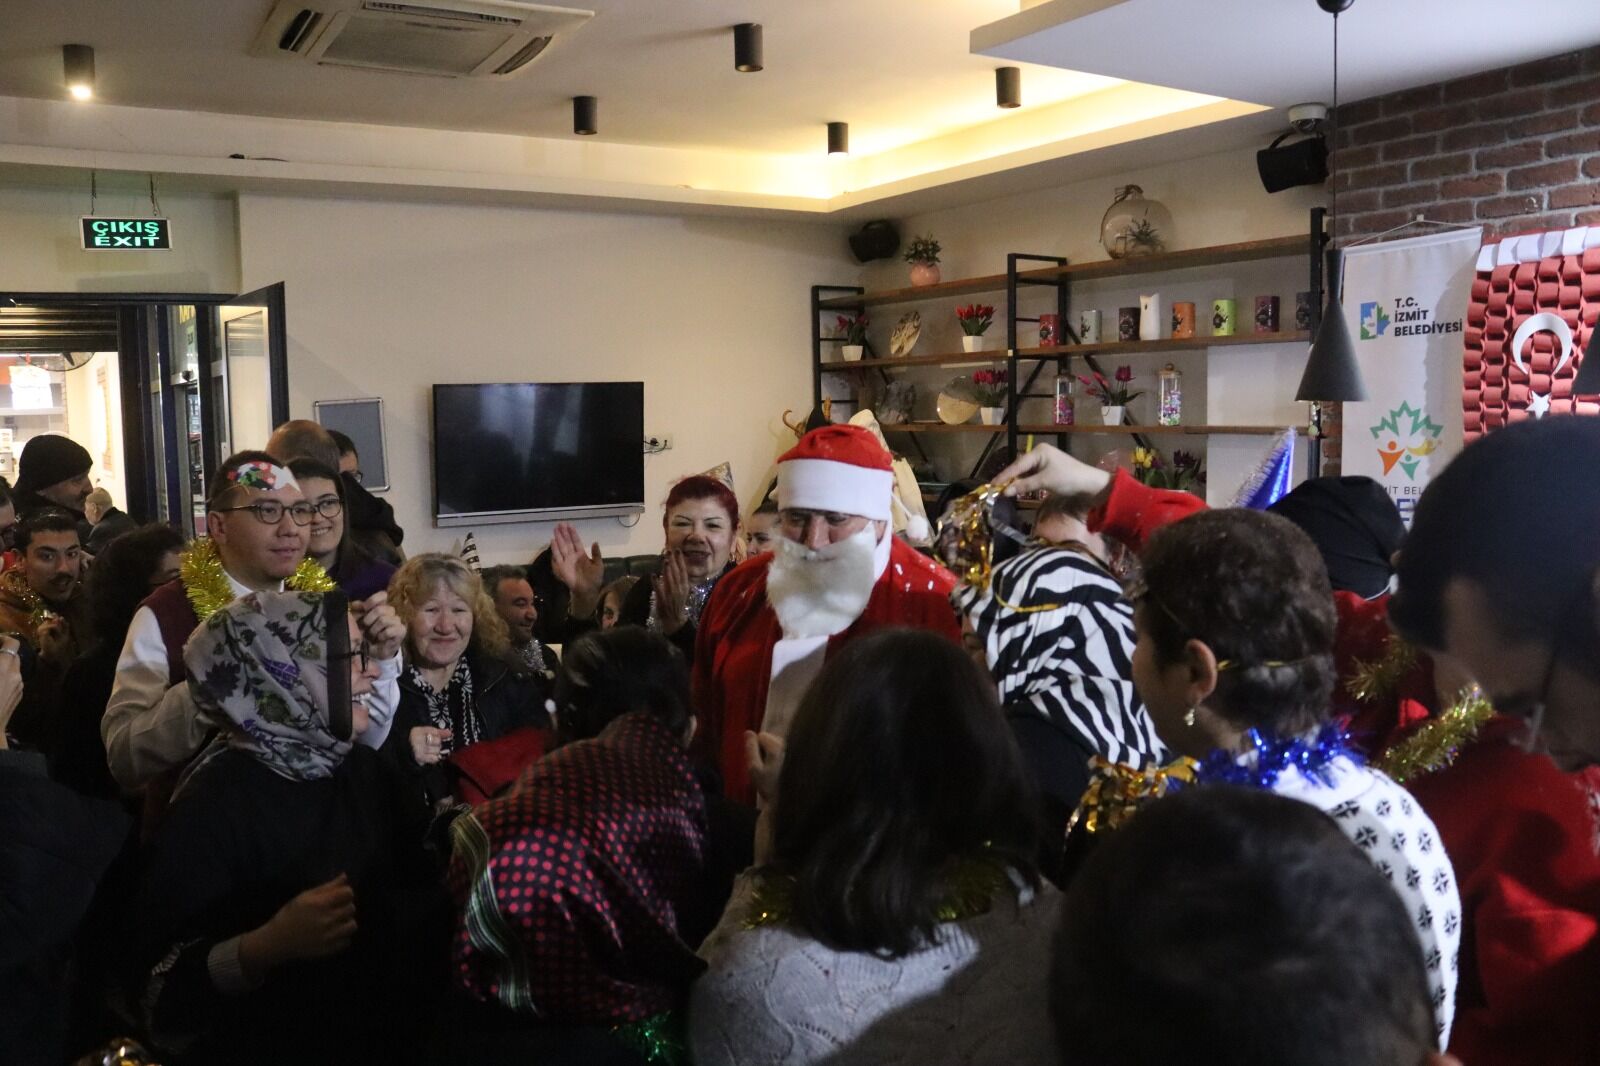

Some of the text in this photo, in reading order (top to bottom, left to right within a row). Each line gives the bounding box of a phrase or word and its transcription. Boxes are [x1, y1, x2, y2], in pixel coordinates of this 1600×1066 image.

[92, 221, 160, 236] ÇIKIŞ
[94, 236, 160, 247] EXIT
[1394, 297, 1418, 308] T.C.
[1394, 308, 1429, 322] İZMİT
[1394, 318, 1463, 336] BELEDİYESİ
[1404, 486, 1423, 495] BEL
